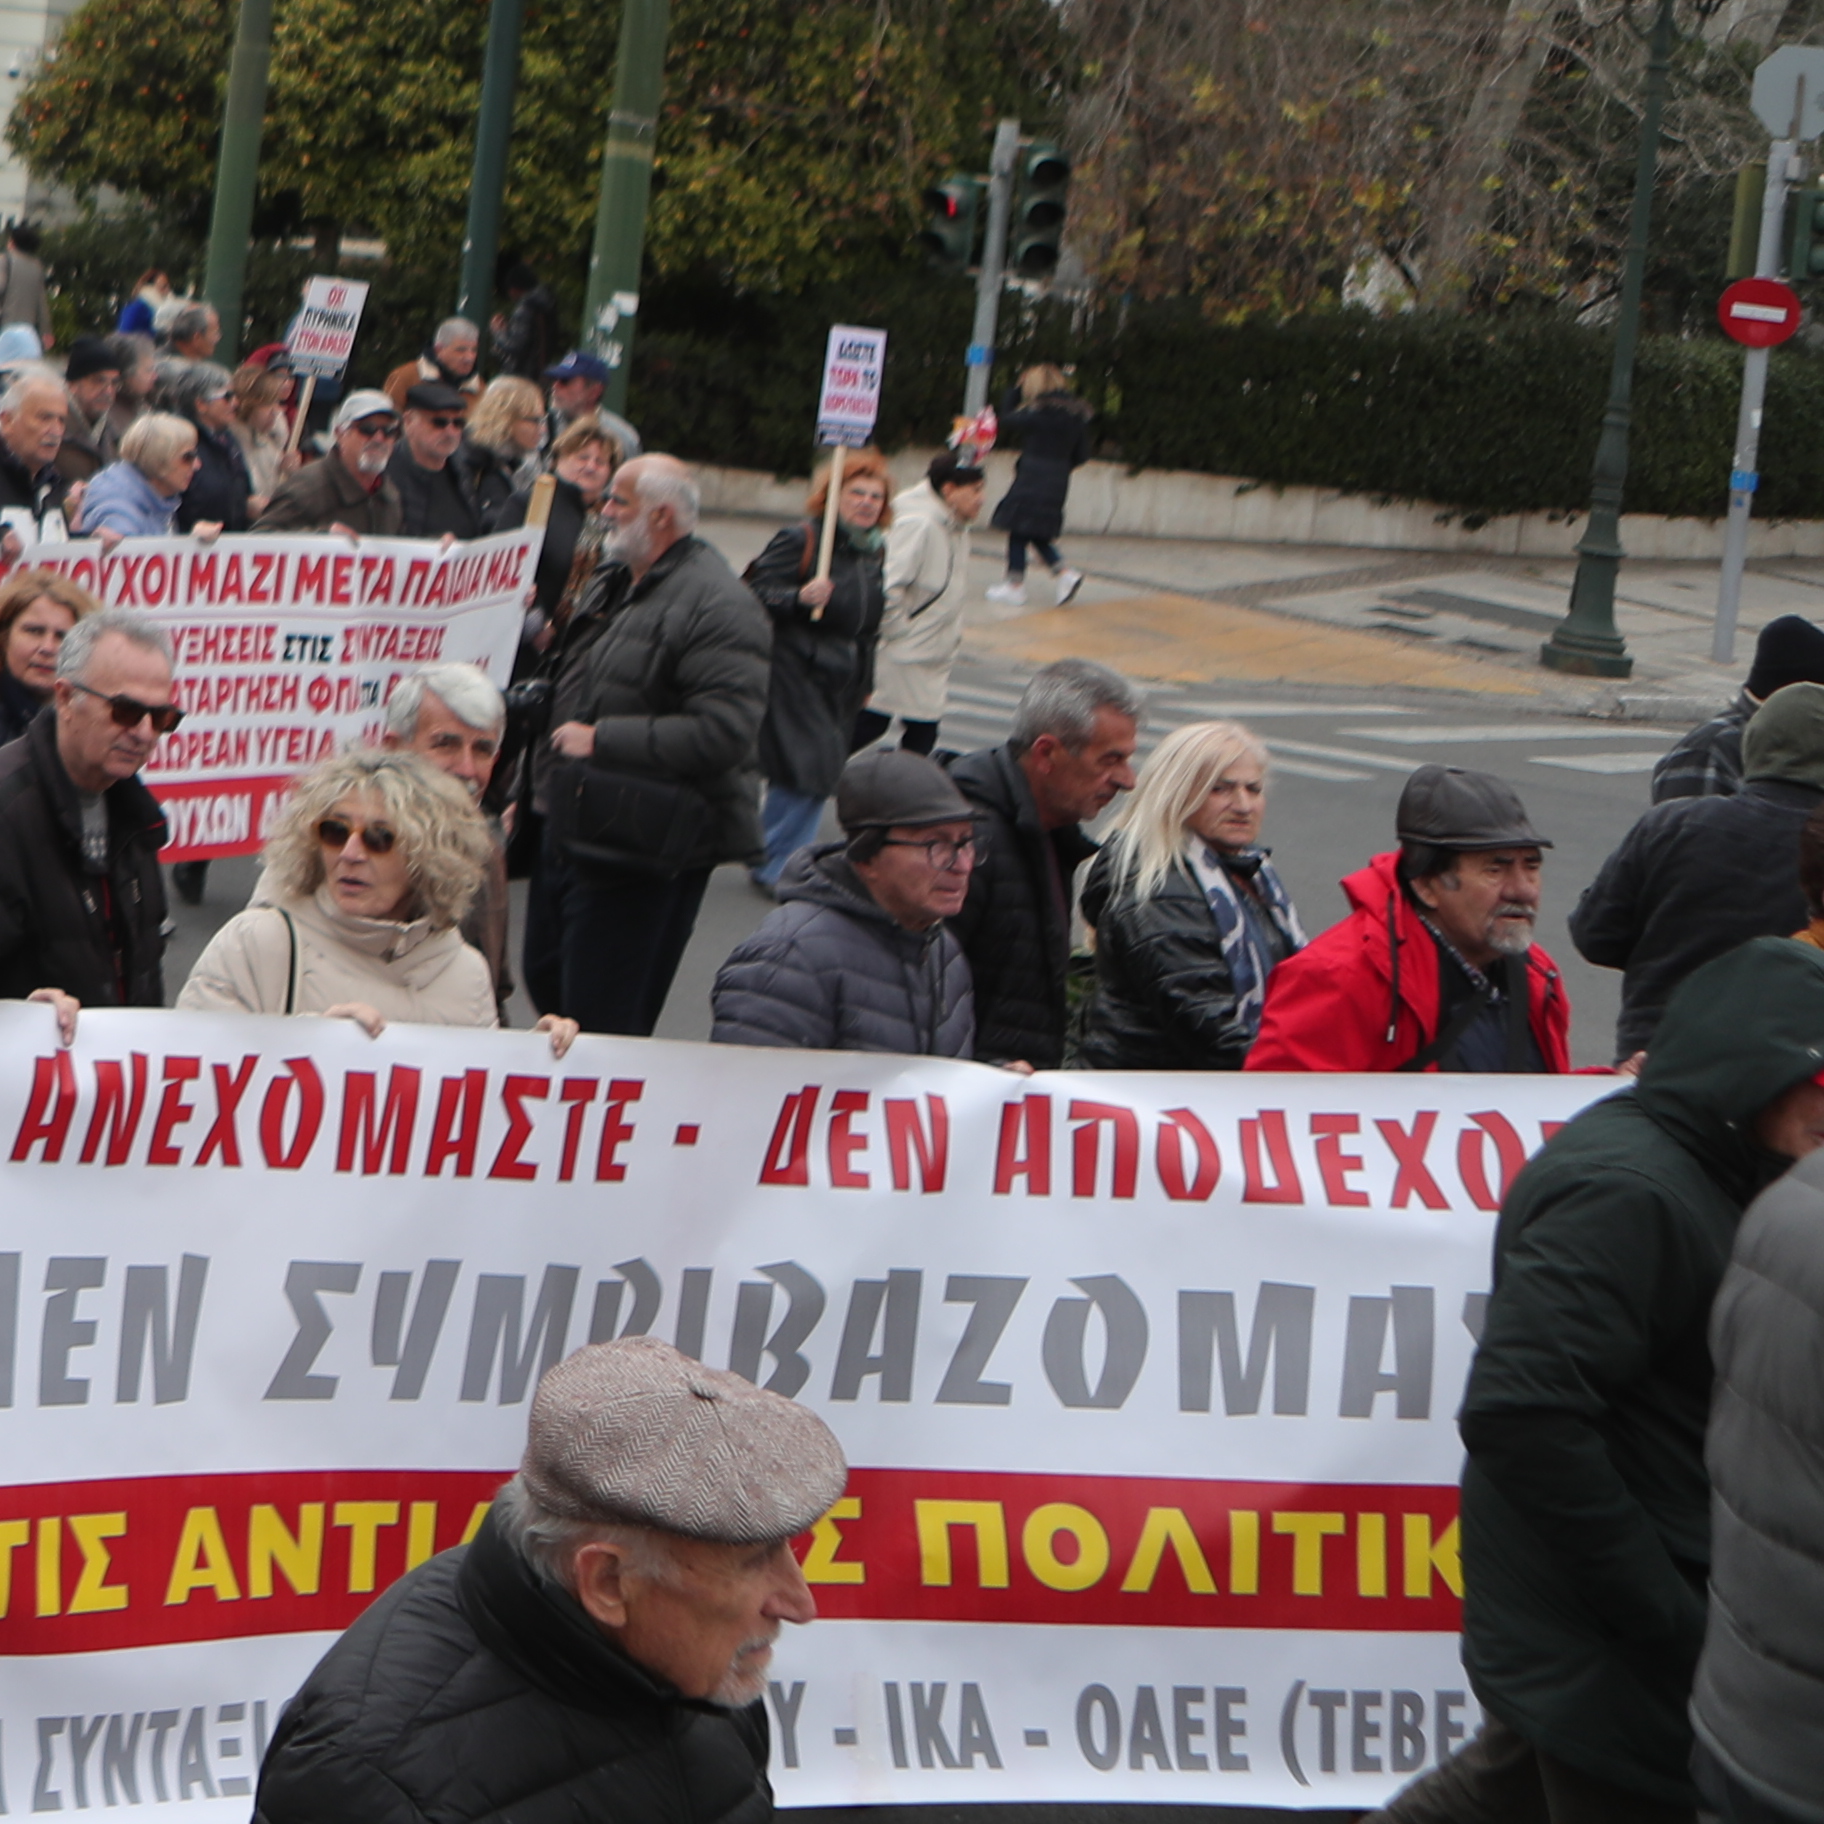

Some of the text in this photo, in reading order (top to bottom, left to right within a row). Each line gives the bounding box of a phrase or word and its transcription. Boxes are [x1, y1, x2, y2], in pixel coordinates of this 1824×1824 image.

[186, 552, 289, 606] ΜΑΖΙ
[291, 553, 396, 607] ΜΕΤΑ
[483, 542, 532, 596] ΜΑΣ
[282, 633, 335, 663] ΣΤΙΣ
[9, 1045, 646, 1185] ΑΝΕΧΟΜΑΣΤΕ
[758, 1084, 951, 1194] ΔΕΝ
[992, 1093, 1569, 1212] ΑΠΟΔΕΧΟ
[263, 1255, 1492, 1422] ΣΥΜΒΙΒΑΖΟΜΑ
[163, 1500, 496, 1606] ΑΝΤΙ
[29, 1698, 294, 1814] ΣΥΝΤΑΞΙ
[883, 1680, 1004, 1771] ΙΚΑ
[1075, 1681, 1249, 1773] ΟΑΕΕ
